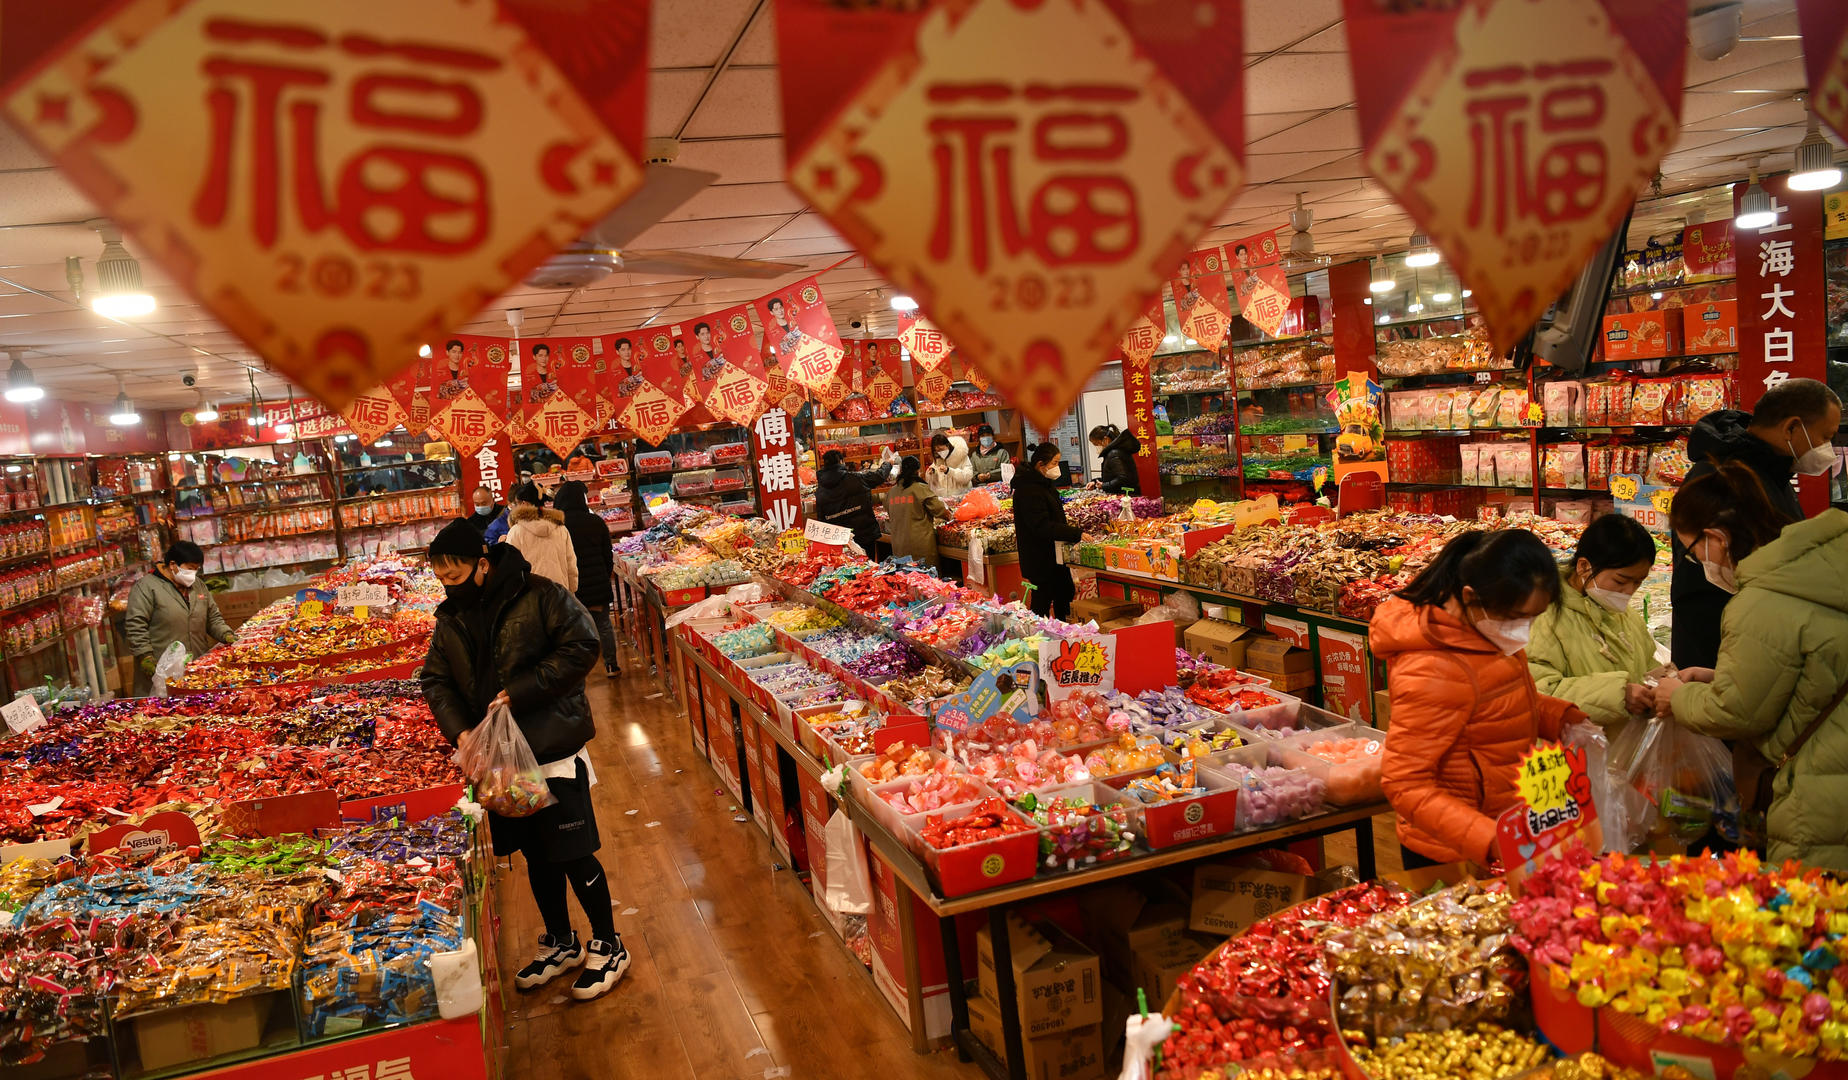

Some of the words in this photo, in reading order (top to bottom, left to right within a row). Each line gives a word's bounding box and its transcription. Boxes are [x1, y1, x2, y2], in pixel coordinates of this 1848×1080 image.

[190, 18, 503, 259] 福
[1463, 60, 1613, 236] 福
[926, 81, 1141, 276] 福
[1254, 294, 1281, 321] 福
[1127, 326, 1153, 351] 福
[1193, 312, 1220, 338] 福
[914, 328, 943, 354] 福
[799, 346, 834, 381] 福
[720, 376, 756, 409] 福
[768, 373, 787, 393] 福
[873, 382, 893, 399] 福
[925, 376, 944, 393] 福
[351, 395, 393, 426] 福
[410, 405, 429, 425] 福
[634, 398, 670, 429] 福
[1131, 360, 1152, 458] 老五花生酥
[449, 409, 489, 437] 福
[544, 410, 579, 437] 福
[474, 438, 504, 503] 食品
[754, 407, 798, 533] 傅糖业
[1617, 482, 1634, 497] 19.8
[1634, 509, 1656, 526] 19.8
[1060, 670, 1101, 685] 店長推介
[127, 835, 162, 849] Nestlé
